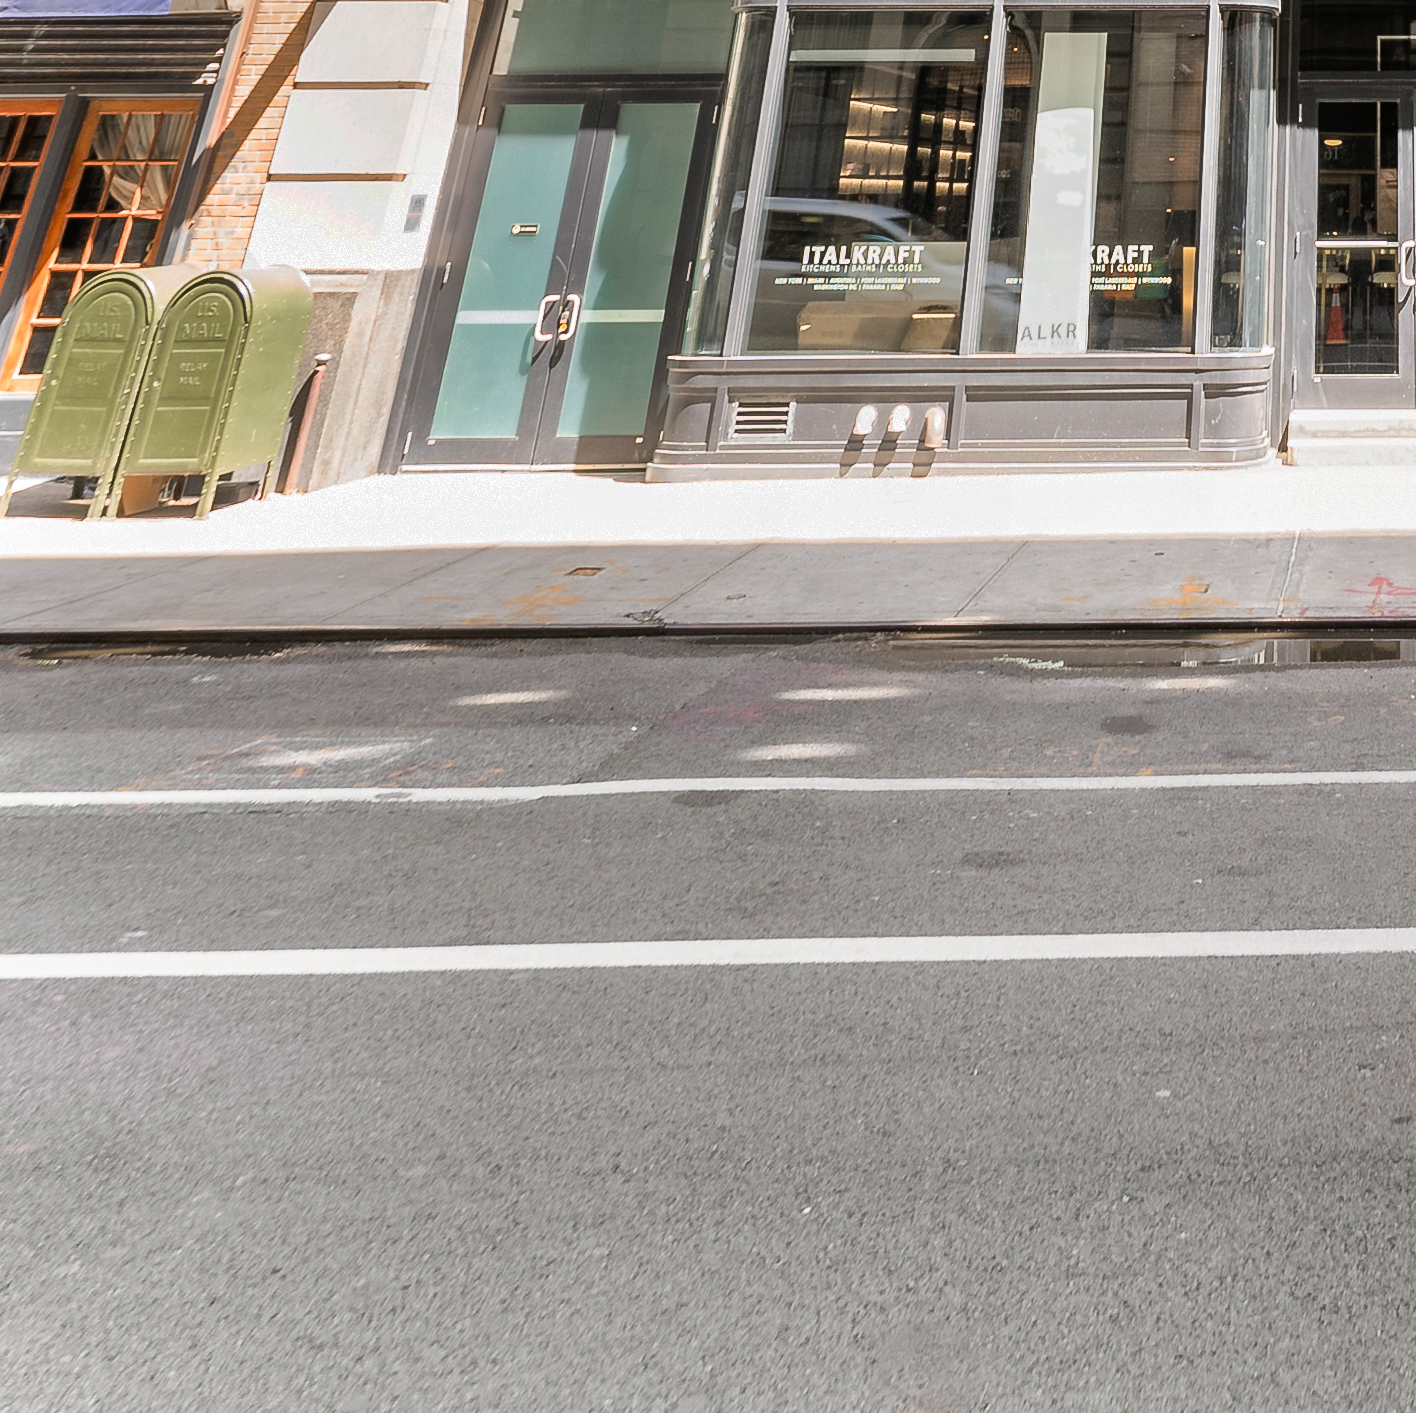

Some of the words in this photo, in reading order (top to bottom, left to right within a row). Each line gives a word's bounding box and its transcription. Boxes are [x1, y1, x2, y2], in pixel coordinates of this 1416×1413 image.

[802, 245, 925, 264] ITALKRAFT
[851, 263, 876, 272] BATHS
[887, 263, 922, 272] CLOSETS
[1116, 263, 1153, 273] CLOSETS
[99, 302, 121, 317] U.S.
[197, 301, 220, 317] U.S.
[79, 322, 124, 339] MAIL
[181, 322, 224, 339] MAIL
[178, 376, 201, 386] MAIL
